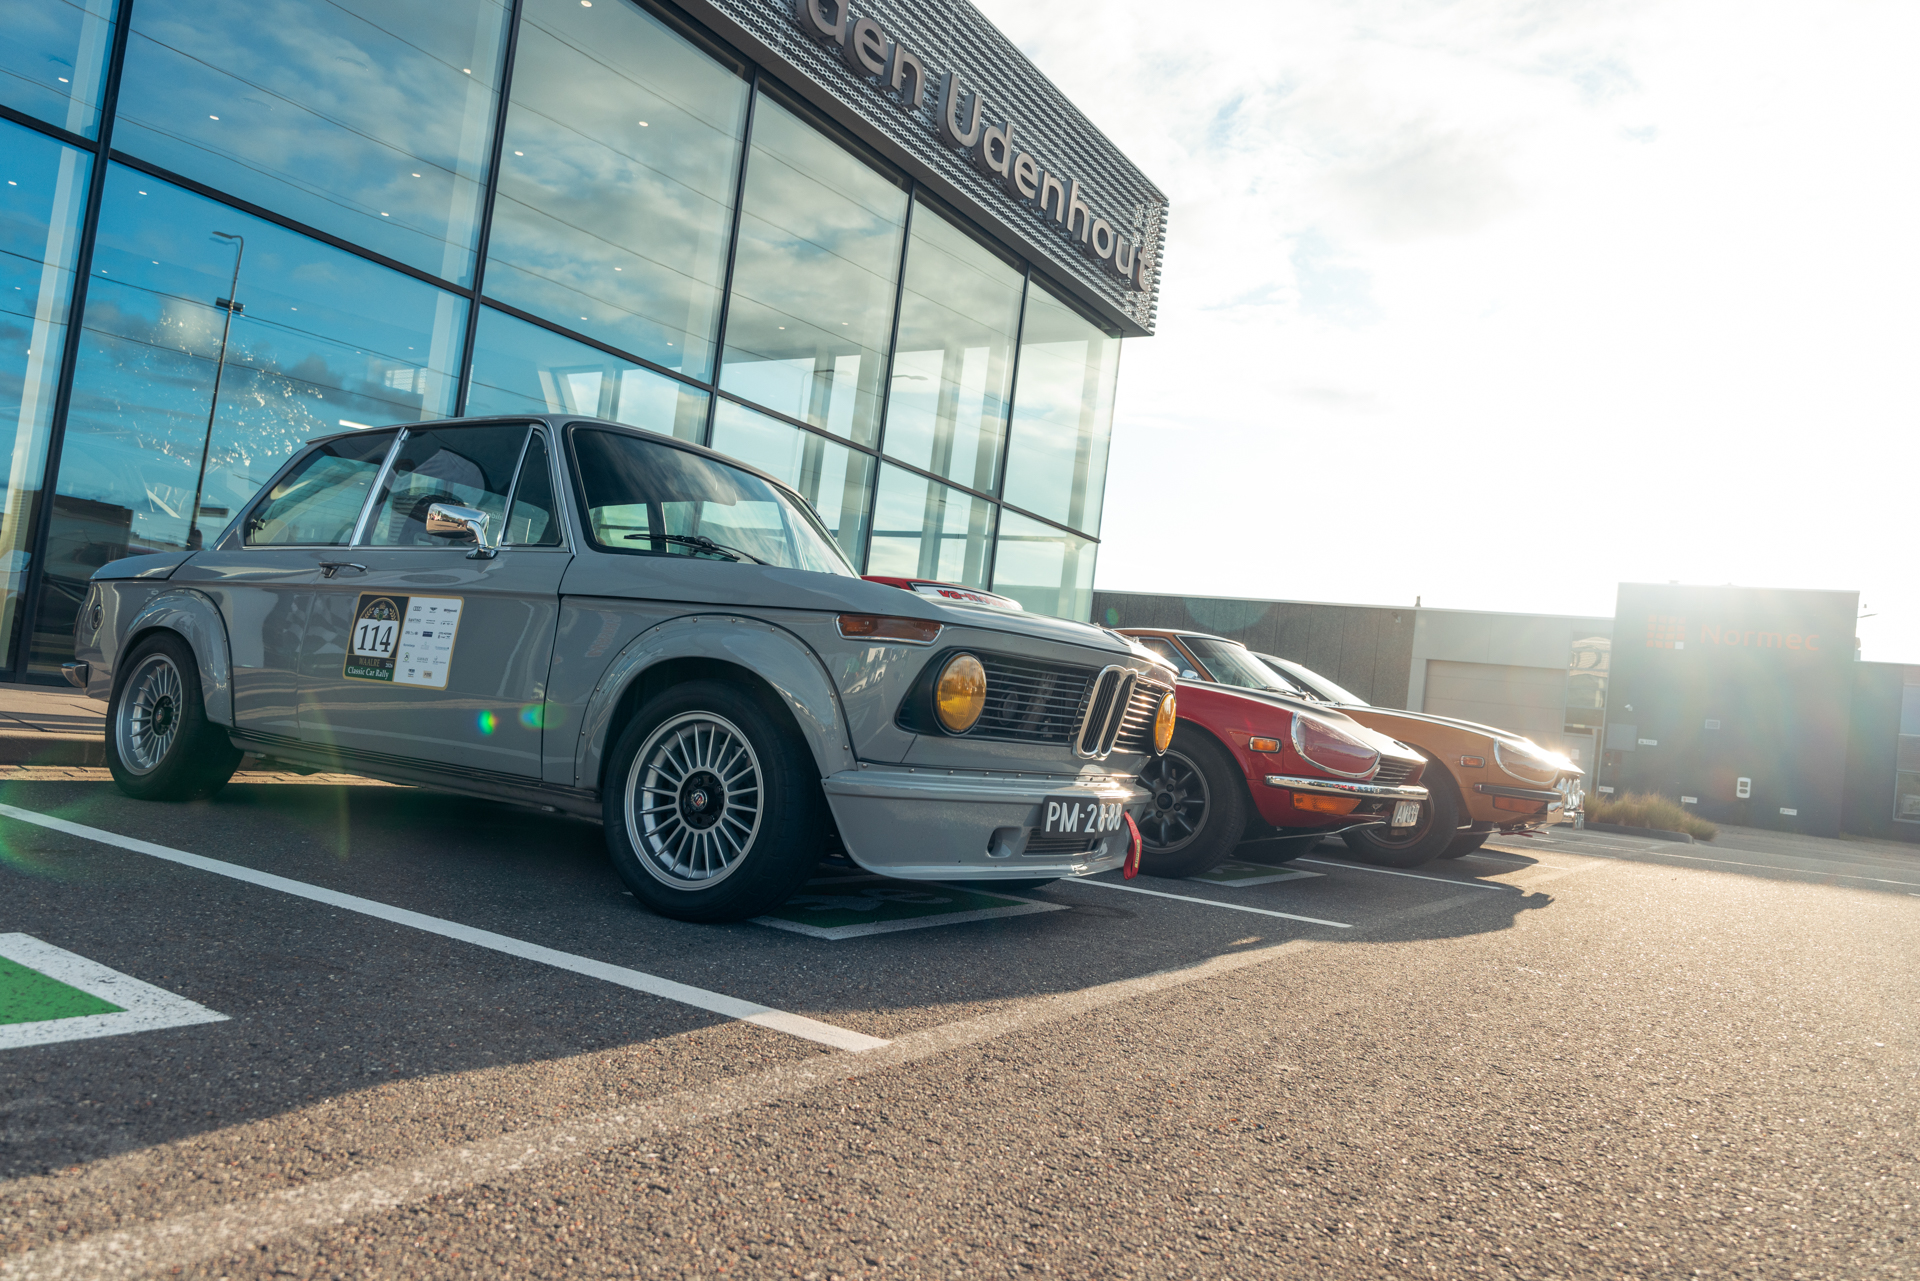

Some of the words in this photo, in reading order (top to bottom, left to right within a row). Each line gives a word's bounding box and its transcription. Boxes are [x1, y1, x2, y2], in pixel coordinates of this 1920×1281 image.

[936, 72, 1152, 292] Udenhout
[357, 624, 392, 653] 114
[1700, 623, 1820, 651] Normec
[347, 666, 365, 675] Classic
[365, 668, 375, 676] Car
[375, 669, 389, 680] Rally
[358, 657, 380, 667] WAALRE
[1045, 801, 1122, 833] PM-28-88
